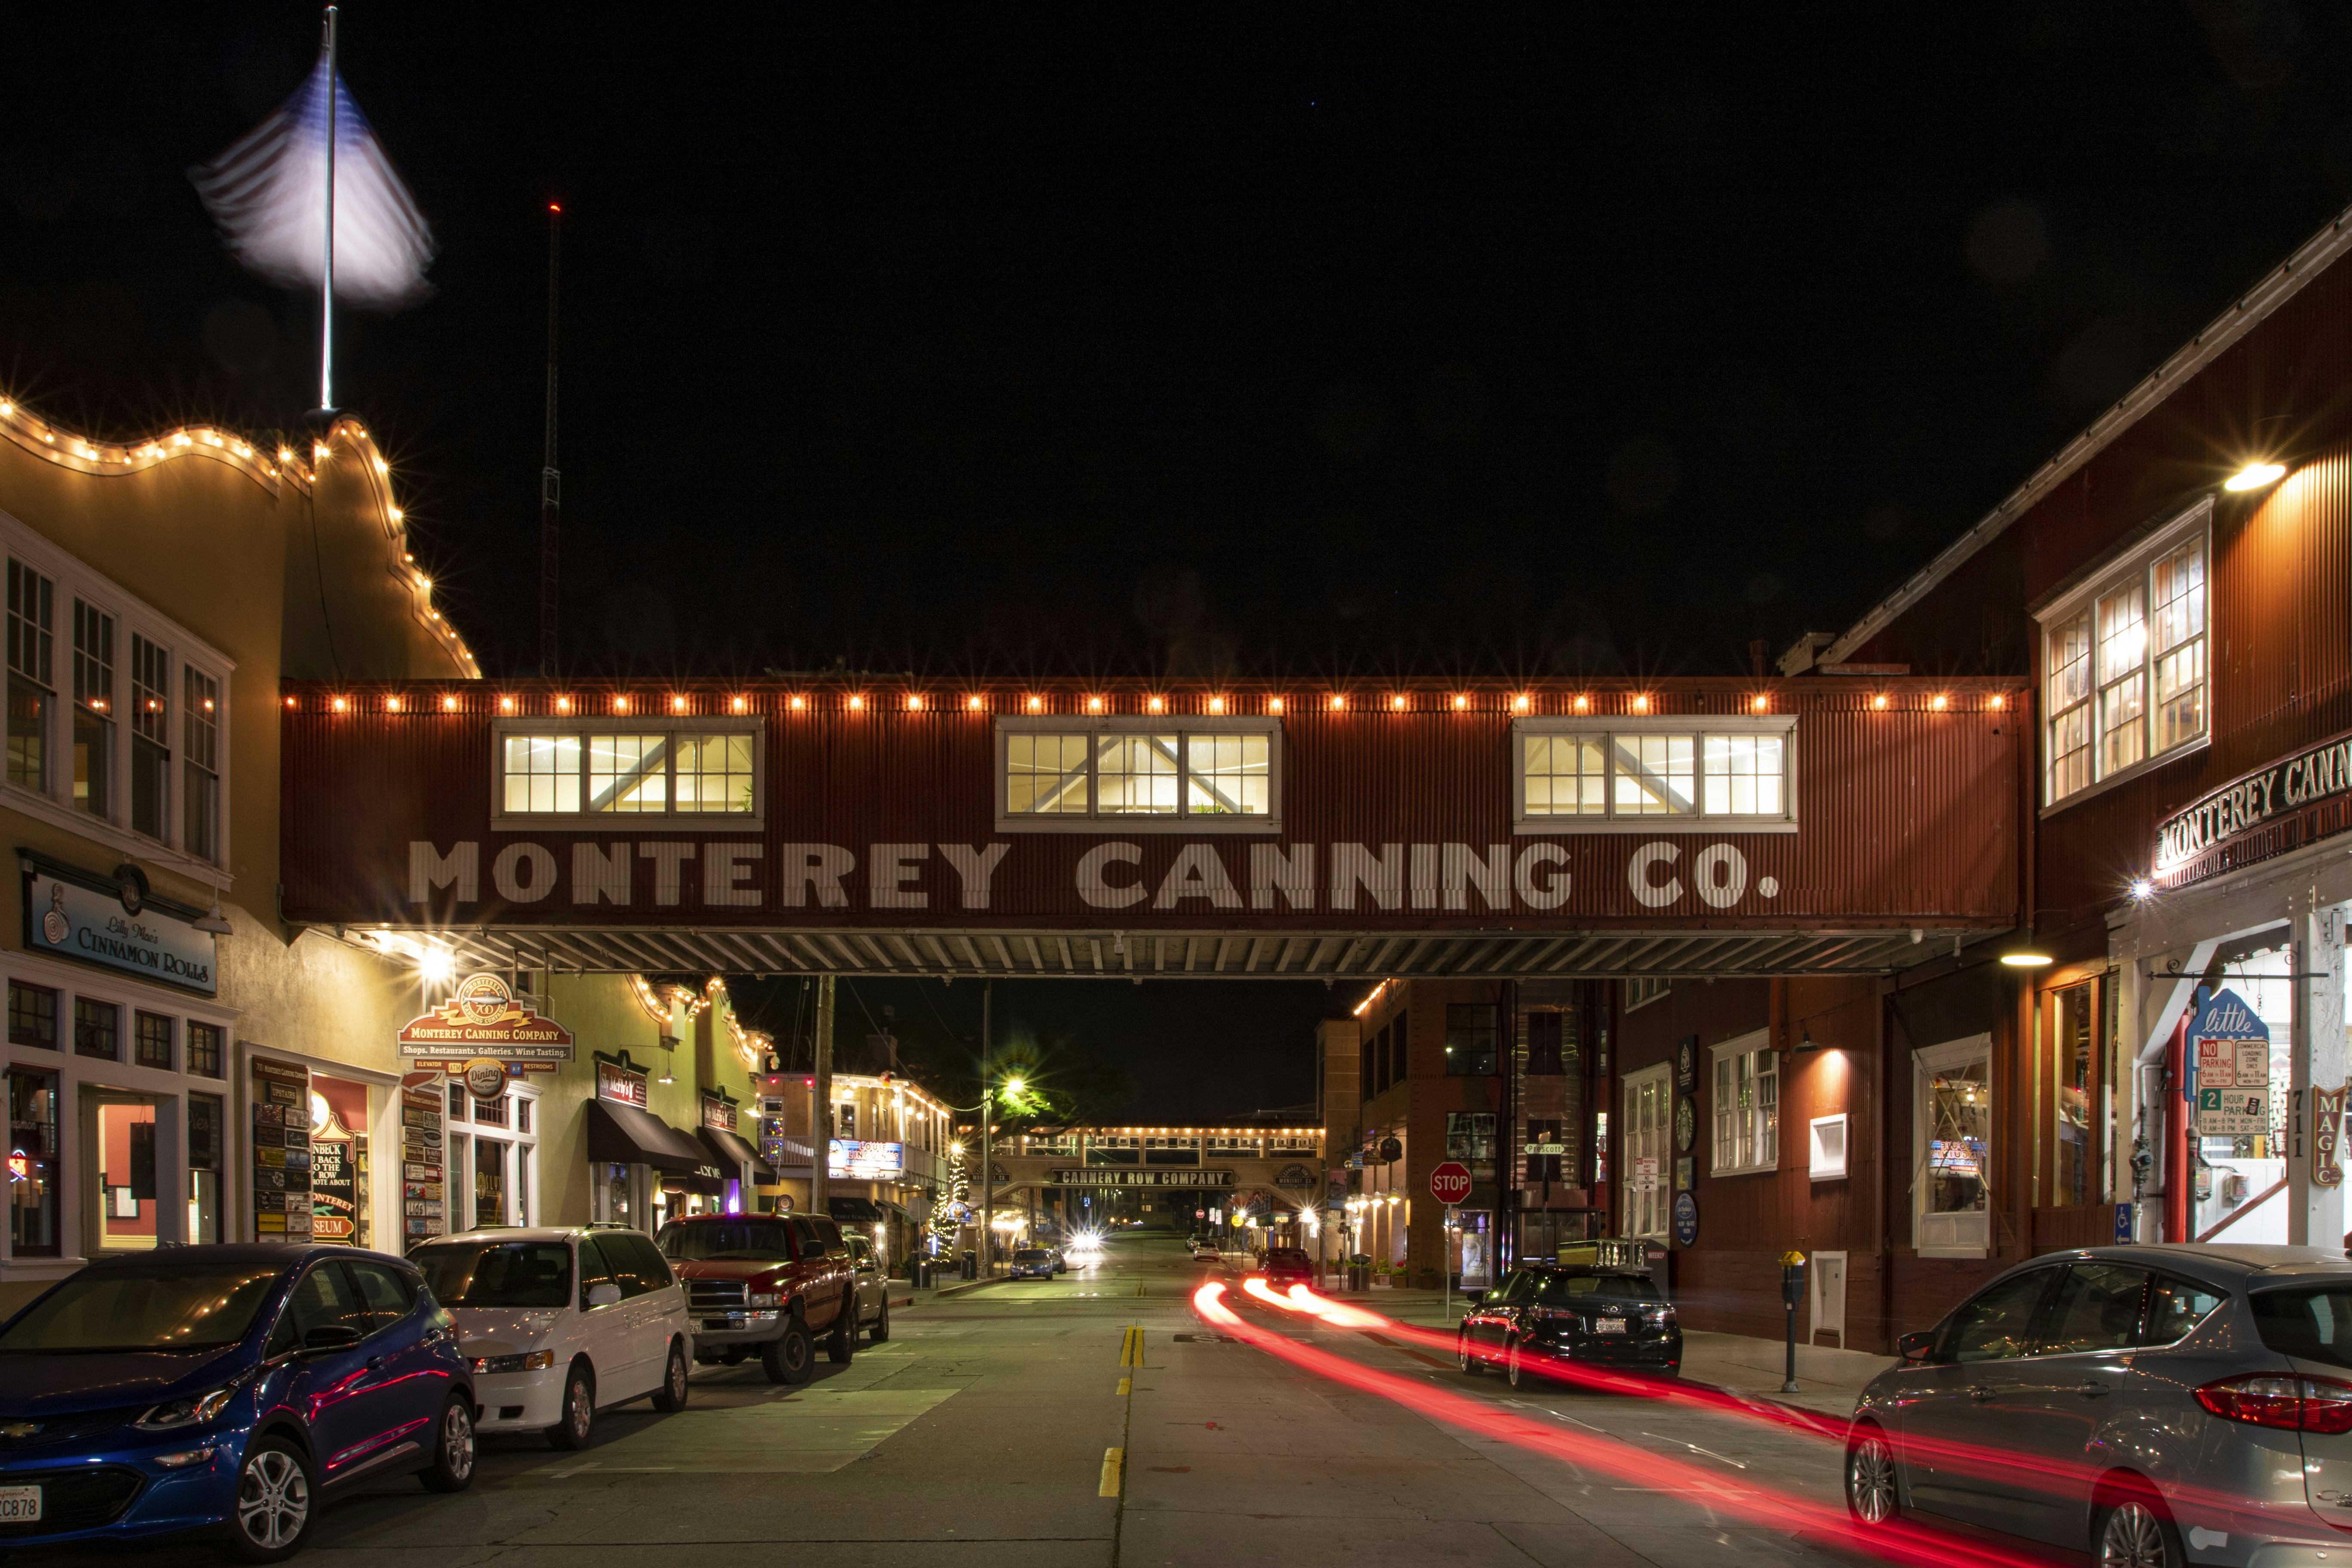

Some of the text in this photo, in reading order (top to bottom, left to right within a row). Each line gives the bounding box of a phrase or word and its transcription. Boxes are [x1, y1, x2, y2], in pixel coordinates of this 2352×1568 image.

[2161, 770, 2277, 864] MONTEREY
[410, 841, 1779, 910] MONTEREY CANNING CO.
[106, 916, 159, 944] Lilly Mae's
[79, 927, 208, 983] CINNAMON ROLLS
[468, 979, 501, 990] MONTEREY
[464, 1004, 505, 1023] CANNING COMPANY
[476, 1004, 494, 1014] 700
[2202, 1003, 2254, 1032] little
[411, 1027, 559, 1041] MONTEREY CANNING COMPANY
[404, 1046, 567, 1058] Shops. Restaurants. Galleries. Wine Tasting.
[2203, 1044, 2216, 1056] NO
[2202, 1059, 2231, 1069] PARKING
[470, 1068, 499, 1083] Dining
[601, 1073, 609, 1093] Sly
[610, 1076, 629, 1097] McFly's
[272, 1088, 296, 1099] UPSTAIRS
[2208, 1092, 2217, 1108] 2
[2223, 1095, 2244, 1104] HOUR
[2224, 1106, 2265, 1115] PARKG
[2318, 1096, 2339, 1182] MAGIC
[313, 1144, 341, 1155] NBECK
[1063, 1172, 1224, 1185] CANNERY ROW COMPANY
[1434, 1176, 1468, 1191] STOP
[313, 1192, 354, 1212] ONTEREY
[409, 1202, 423, 1215] Lids
[314, 1220, 342, 1233] SEUM
